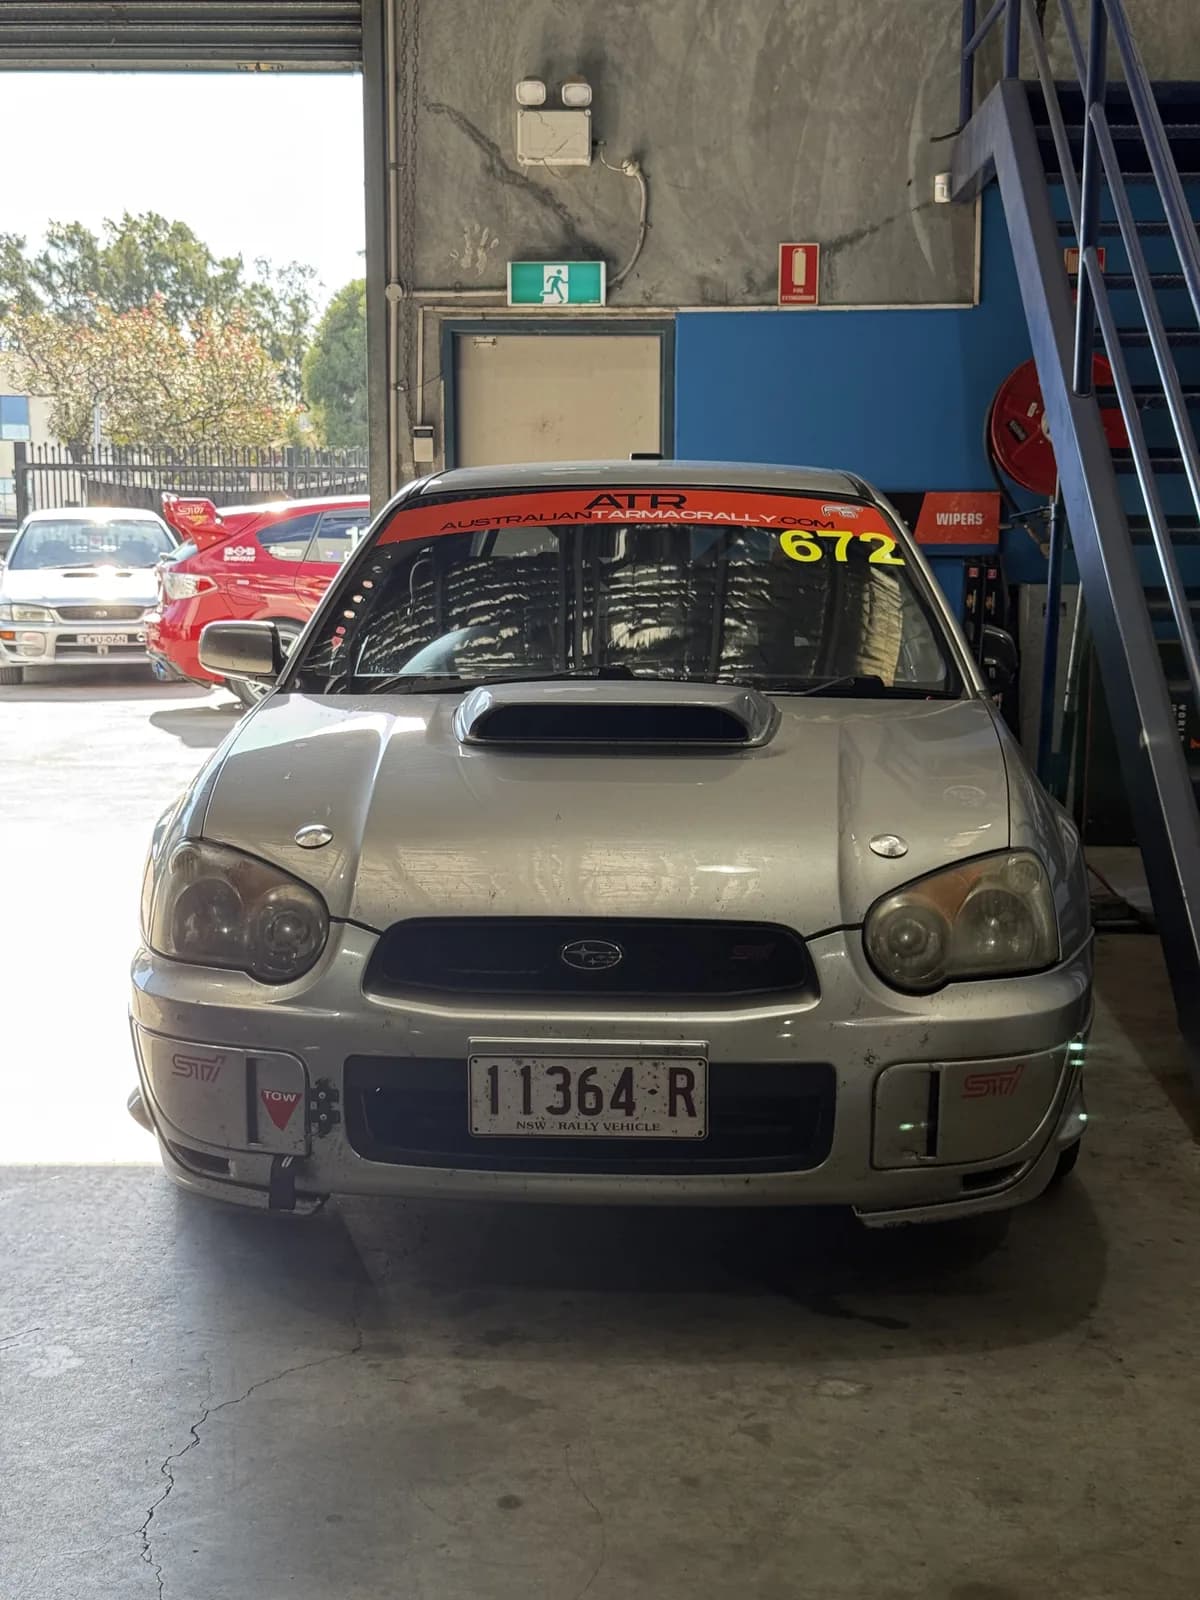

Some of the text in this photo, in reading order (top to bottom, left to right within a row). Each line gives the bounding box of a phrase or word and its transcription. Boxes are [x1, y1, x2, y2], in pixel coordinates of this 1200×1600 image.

[584, 493, 687, 510] ATR
[440, 510, 834, 531] AUSTRALIANTARMACRALLY.COM
[936, 512, 984, 526] WIPERS
[779, 529, 906, 566] 672
[263, 1090, 297, 1103] TOW
[516, 1120, 662, 1132] NSW RALLY VEHICLE
